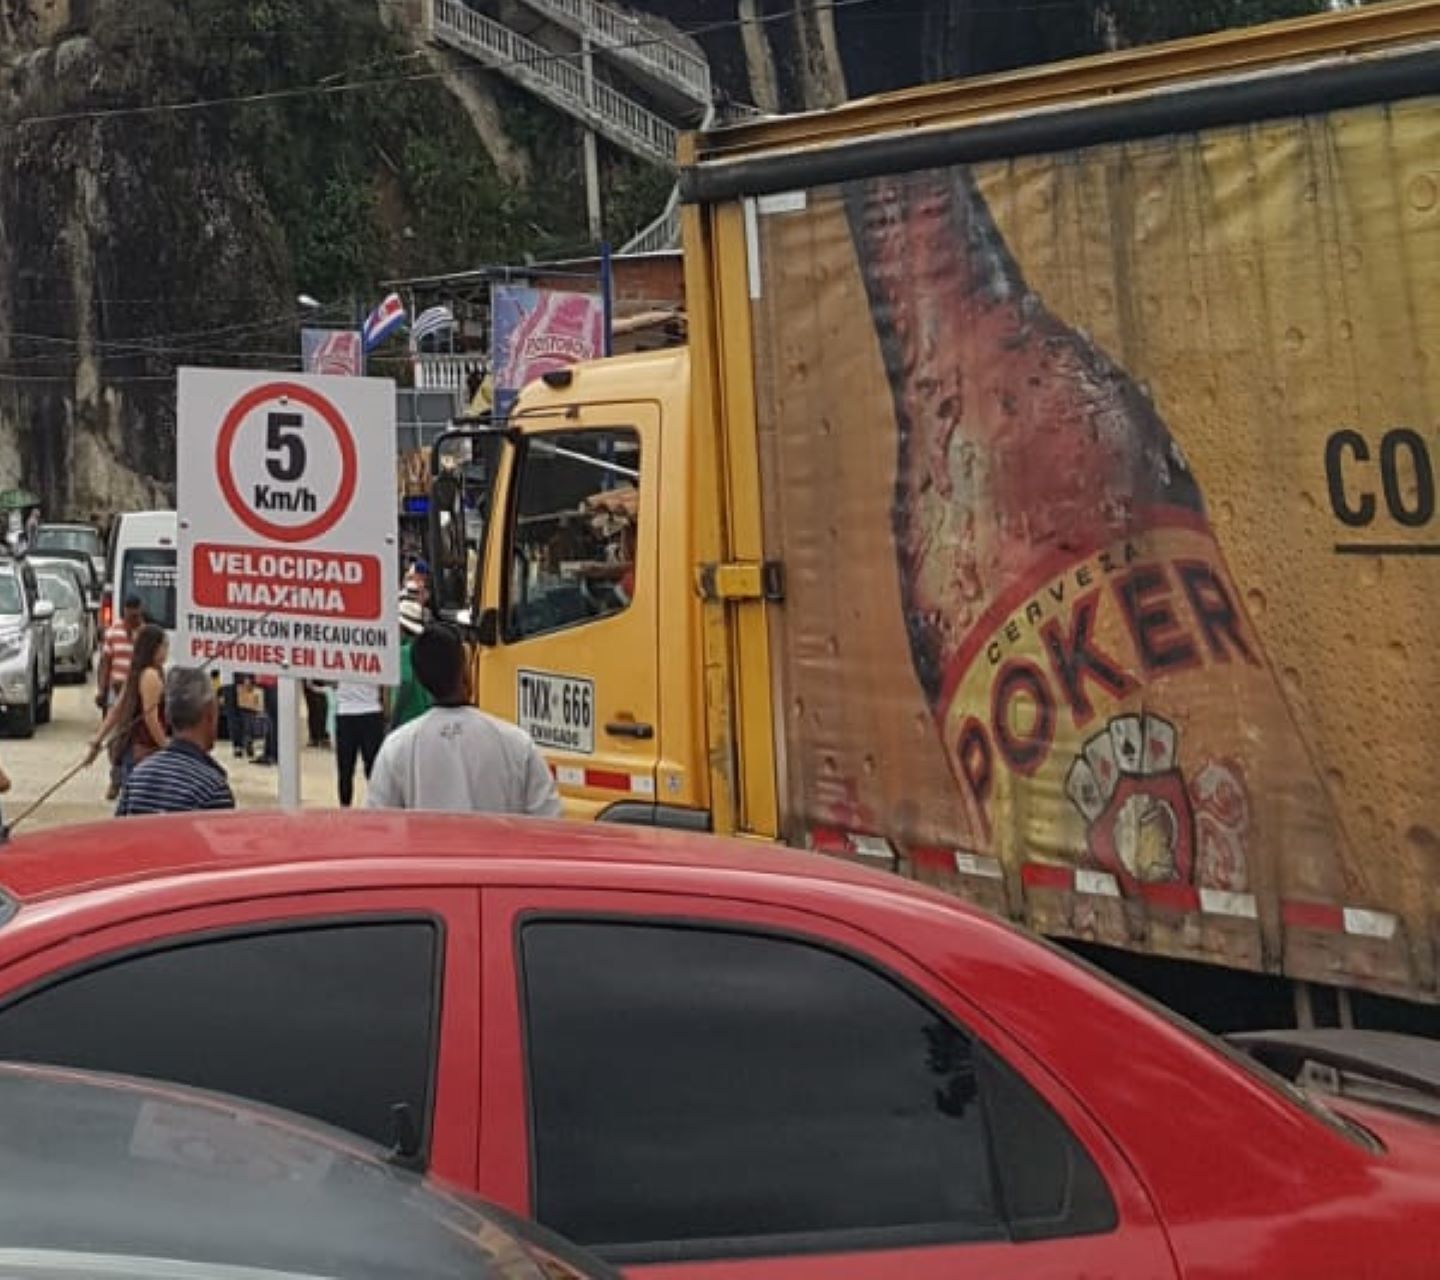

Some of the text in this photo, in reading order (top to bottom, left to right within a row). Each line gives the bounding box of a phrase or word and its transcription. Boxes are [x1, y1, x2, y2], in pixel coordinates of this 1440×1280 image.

[265, 412, 307, 483] 5
[254, 484, 317, 512] Km/h
[207, 551, 363, 585] VELOCIDAD
[987, 543, 1137, 666] CERVEZA
[187, 614, 388, 648] TRANSITE CON PRECAUCION
[190, 638, 382, 674] PEATONES EN LA VIA
[955, 557, 1263, 848] POKER
